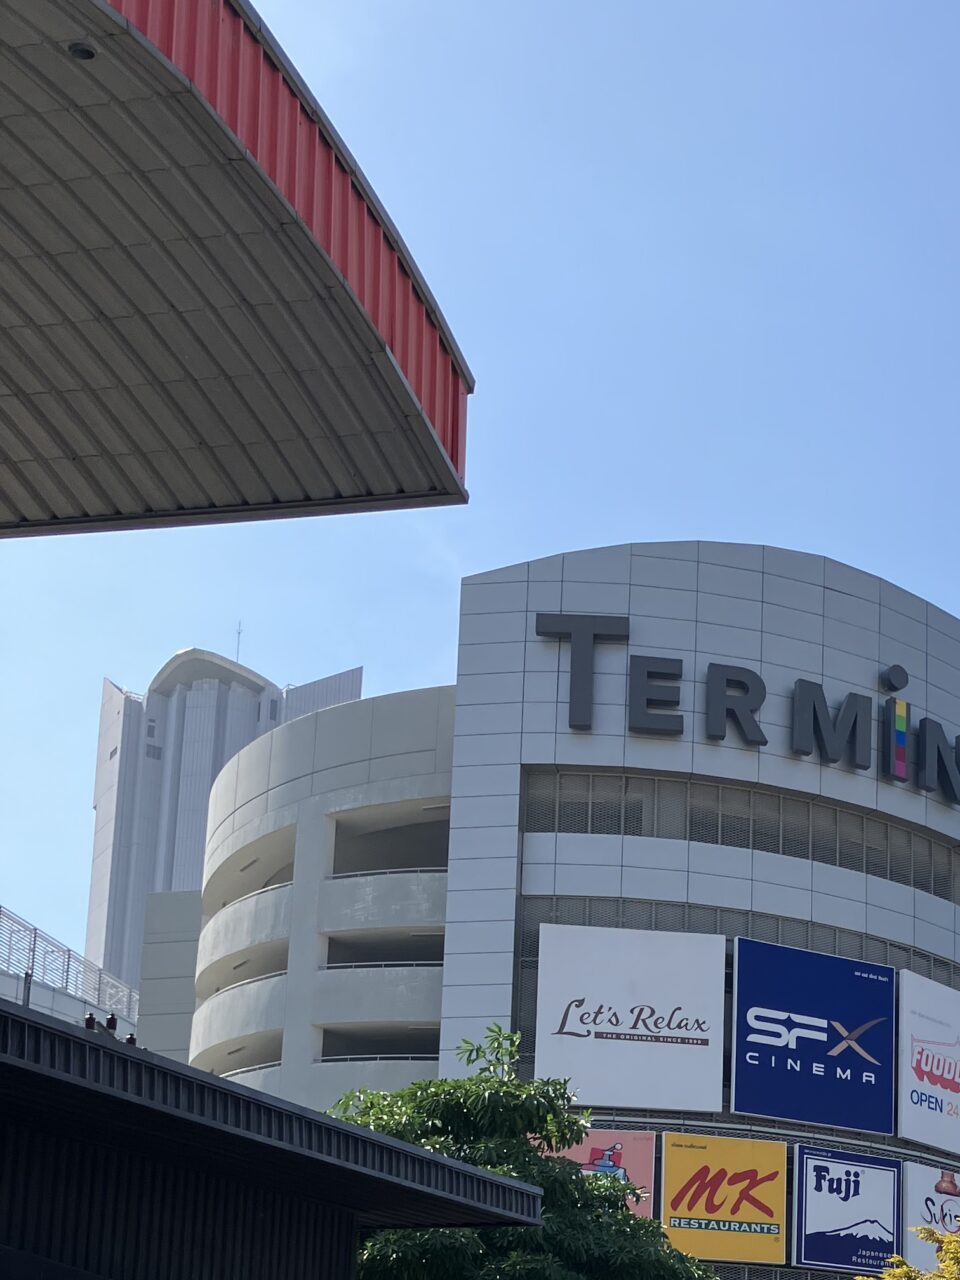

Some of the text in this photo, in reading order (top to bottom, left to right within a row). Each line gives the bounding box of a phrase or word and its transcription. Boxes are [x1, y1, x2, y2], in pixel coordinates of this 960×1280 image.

[551, 997, 711, 1038] Let's Relax
[746, 1006, 888, 1066] SFX
[745, 1052, 876, 1085] CINEMA
[910, 1089, 943, 1113] OPEN
[946, 1101, 959, 1118] 24
[670, 1164, 779, 1218] MK
[813, 1164, 860, 1202] Fuji
[670, 1217, 779, 1234] RESTAURANTS
[857, 1248, 893, 1258] Japanese
